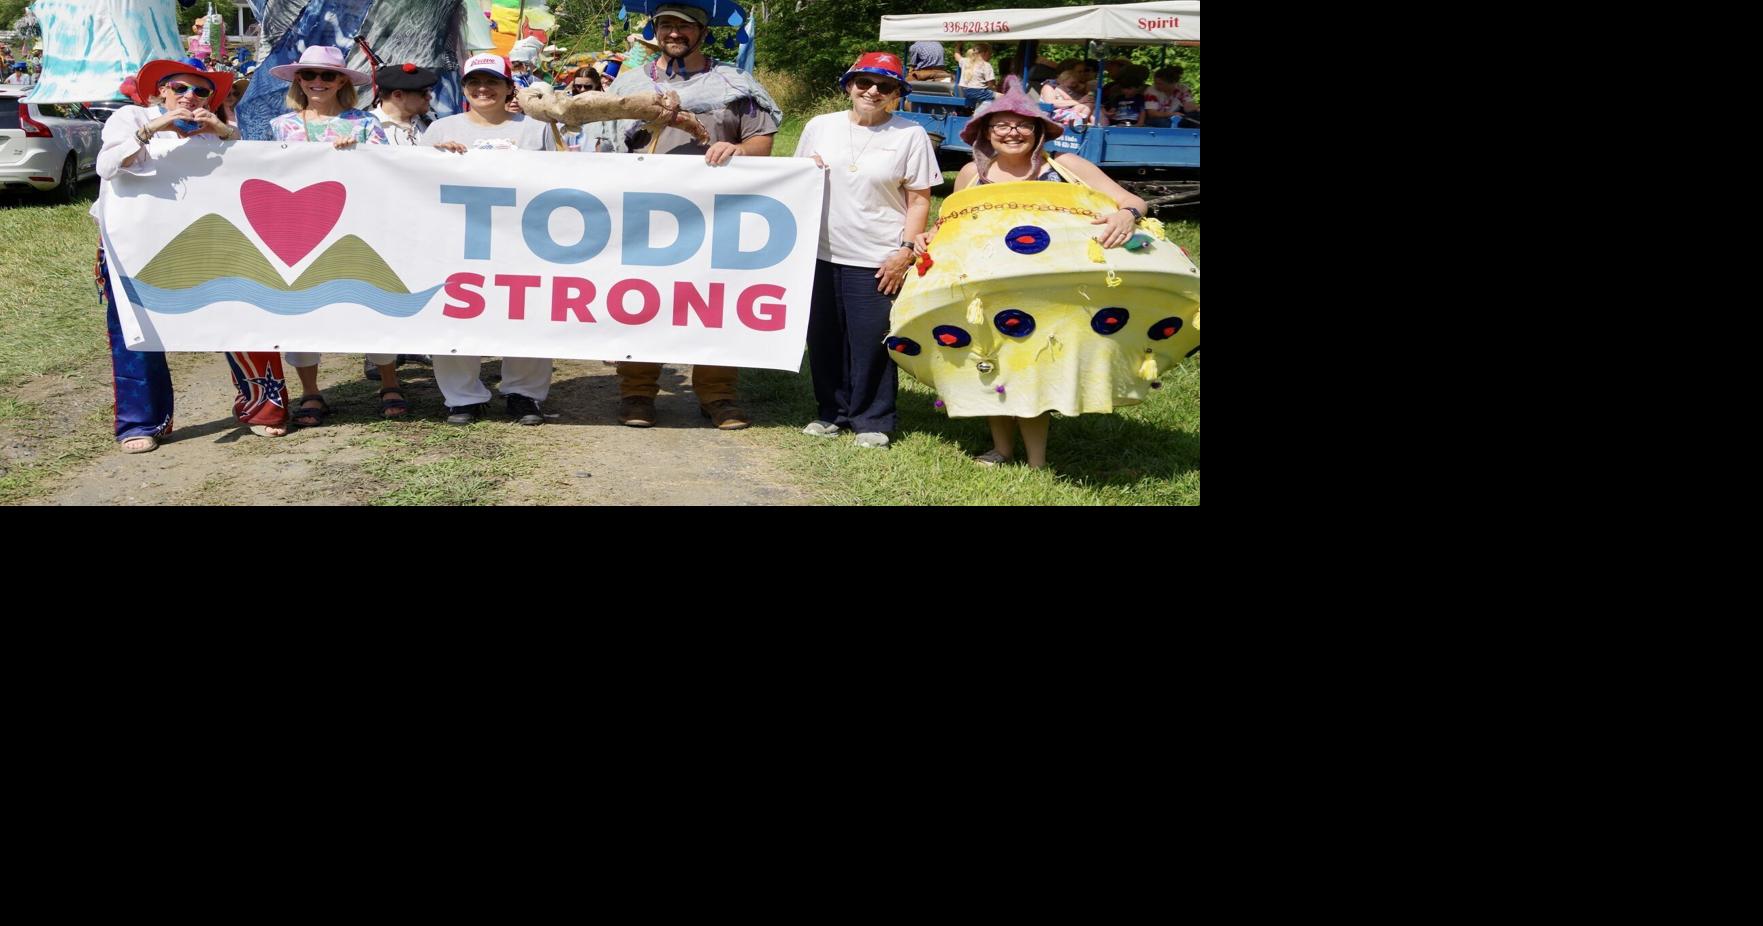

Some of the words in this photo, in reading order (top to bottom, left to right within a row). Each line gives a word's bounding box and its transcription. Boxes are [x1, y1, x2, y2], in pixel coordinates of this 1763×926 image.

[943, 21, 1010, 33] 336-620-3156
[1137, 16, 1180, 31] Spirit
[440, 184, 798, 270] TODD
[442, 272, 787, 332] STRONG
